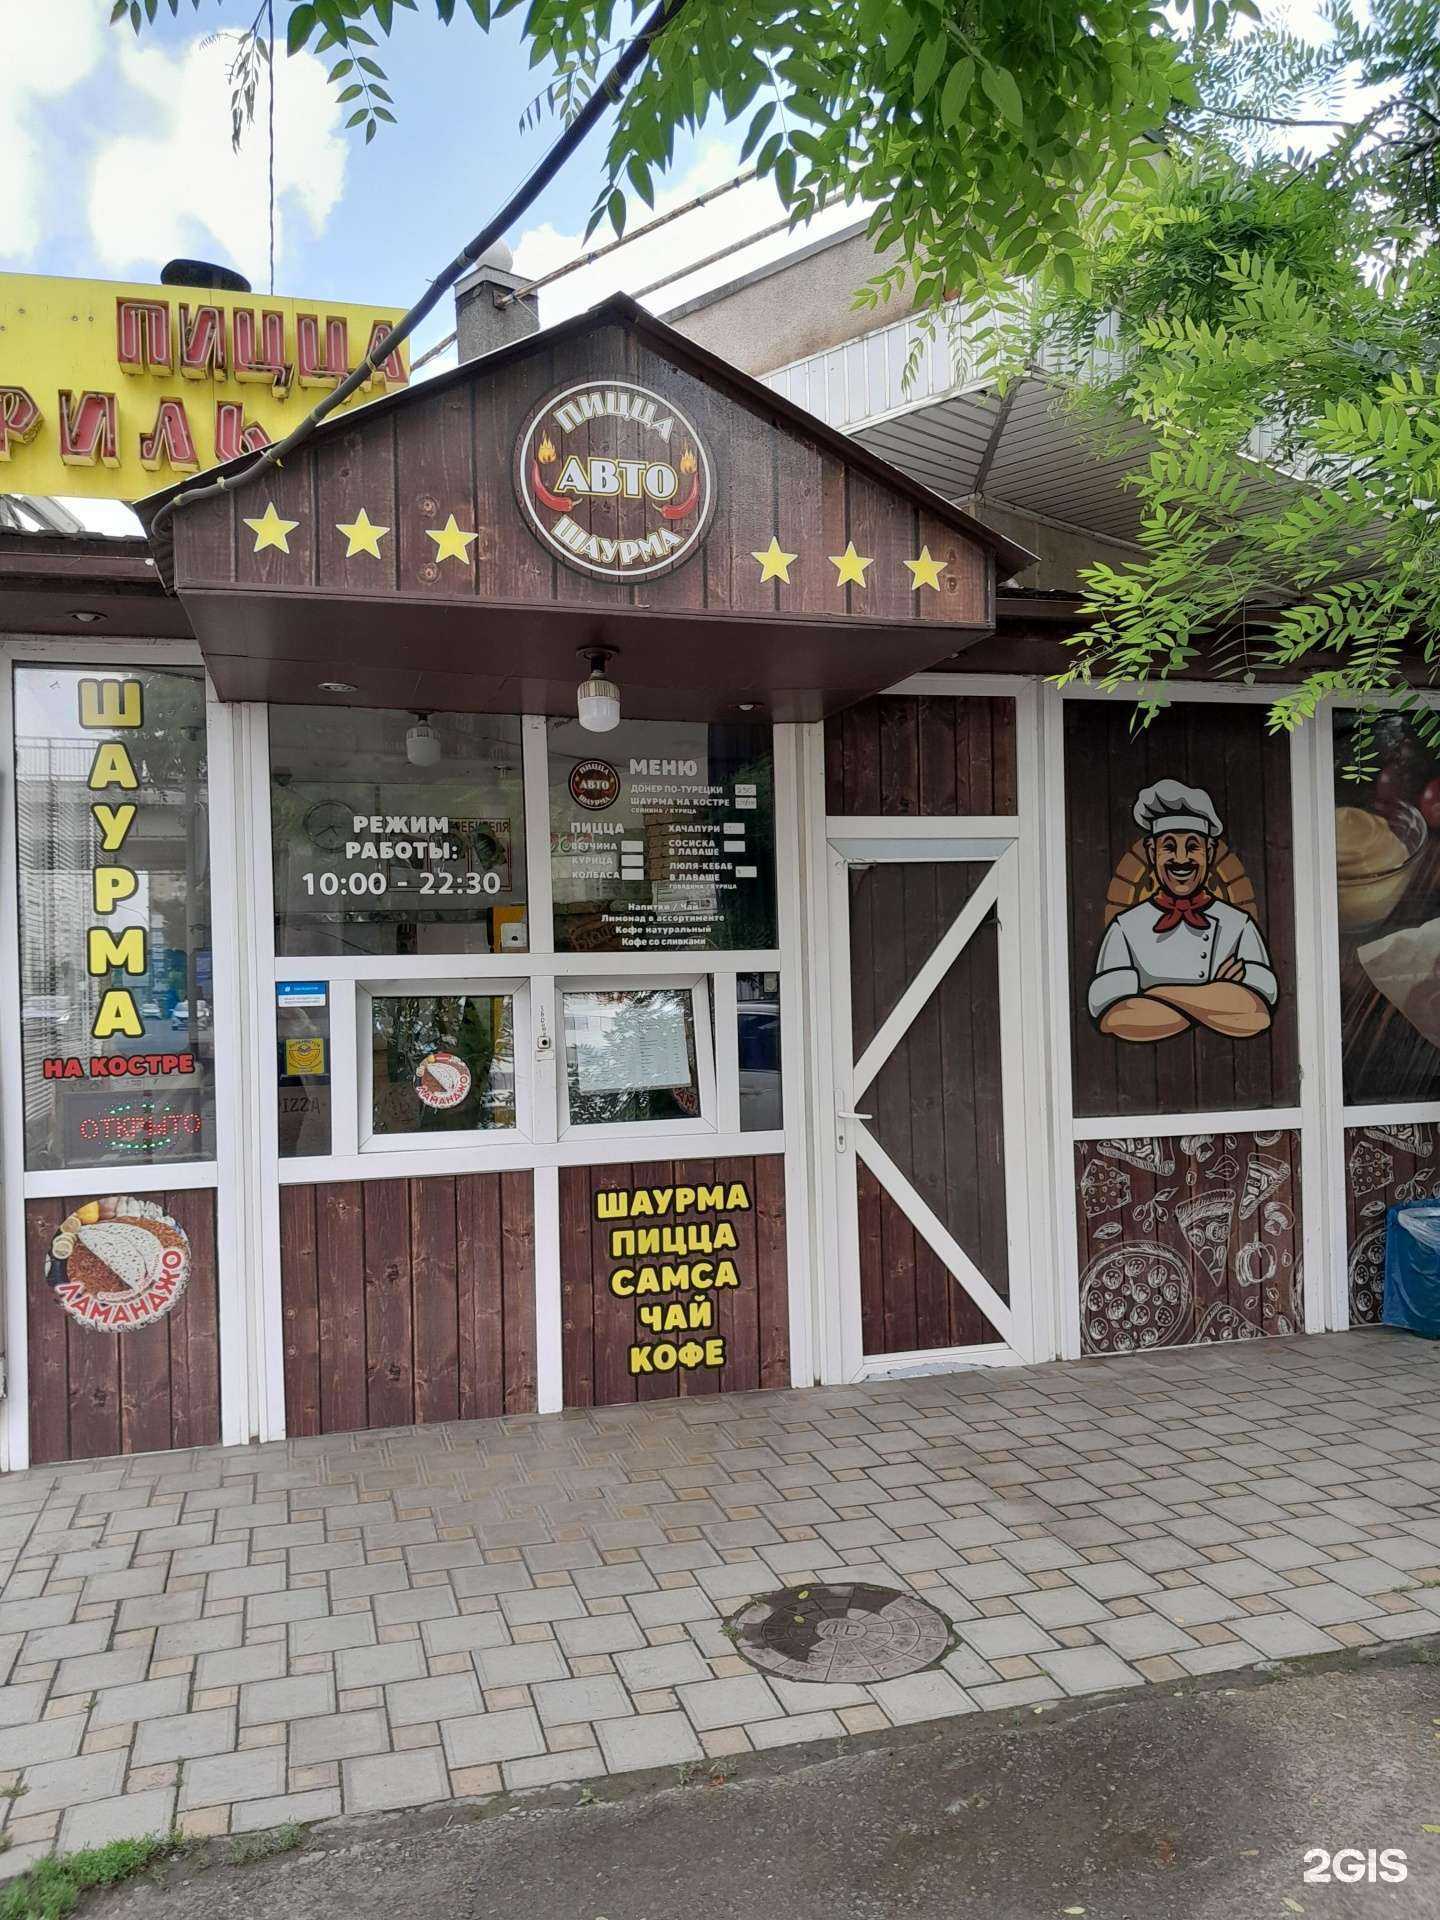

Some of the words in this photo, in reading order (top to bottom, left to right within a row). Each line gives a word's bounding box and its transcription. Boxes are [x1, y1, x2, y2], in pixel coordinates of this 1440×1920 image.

[116, 297, 410, 402] ПИЦЦА
[553, 391, 675, 443] ПИЦЦА
[554, 455, 679, 500] АВТО
[551, 515, 685, 565] ШАУРМА
[629, 758, 698, 777] МЕНЮ
[579, 779, 610, 790] АВТО
[630, 784, 663, 794] ДОНЕР
[664, 785, 724, 796] ПО-ТУРЕЦКИ
[630, 797, 674, 806] ШАУРМА
[675, 798, 691, 806] НА
[693, 798, 731, 807] КОСТРЕ
[353, 815, 449, 834] РЕЖИМ
[570, 822, 625, 835] ПИЦЦА
[668, 825, 720, 833] ХАЧАПУРИ
[345, 842, 458, 860] РАБОТЫ:
[571, 842, 618, 850] ВЕТЧИНА
[668, 848, 675, 856] В
[678, 848, 720, 856] ЛАВАШЕ
[78, 678, 147, 1039] ШАУРМА
[572, 856, 613, 865] КУРИЦА
[669, 862, 733, 870] ЛЮЛЯ-КЕБАБ
[302, 872, 387, 895] 10:00
[419, 872, 501, 895] 22:30
[572, 871, 621, 879] КОЛБАСА
[669, 873, 676, 881] В
[679, 873, 720, 881] ЛАВАШЕ
[628, 903, 670, 911] Напитки
[601, 914, 646, 923] Лимонад
[656, 914, 725, 923] ассортименте
[615, 926, 643, 935] Кофе
[645, 925, 712, 934] натуральный
[621, 938, 647, 947] Кофе
[661, 938, 706, 946] сливками
[43, 1057, 84, 1079] НА
[90, 1053, 195, 1077] КОСТРЕ
[79, 1113, 202, 1140] ОТКРЫТО
[596, 1182, 750, 1220] ШАУРМА
[611, 1222, 738, 1257] ПИЦЦА
[610, 1260, 739, 1297] САМСА
[639, 1294, 712, 1332] ЧАЙ
[629, 1338, 725, 1374] КОФЕ
